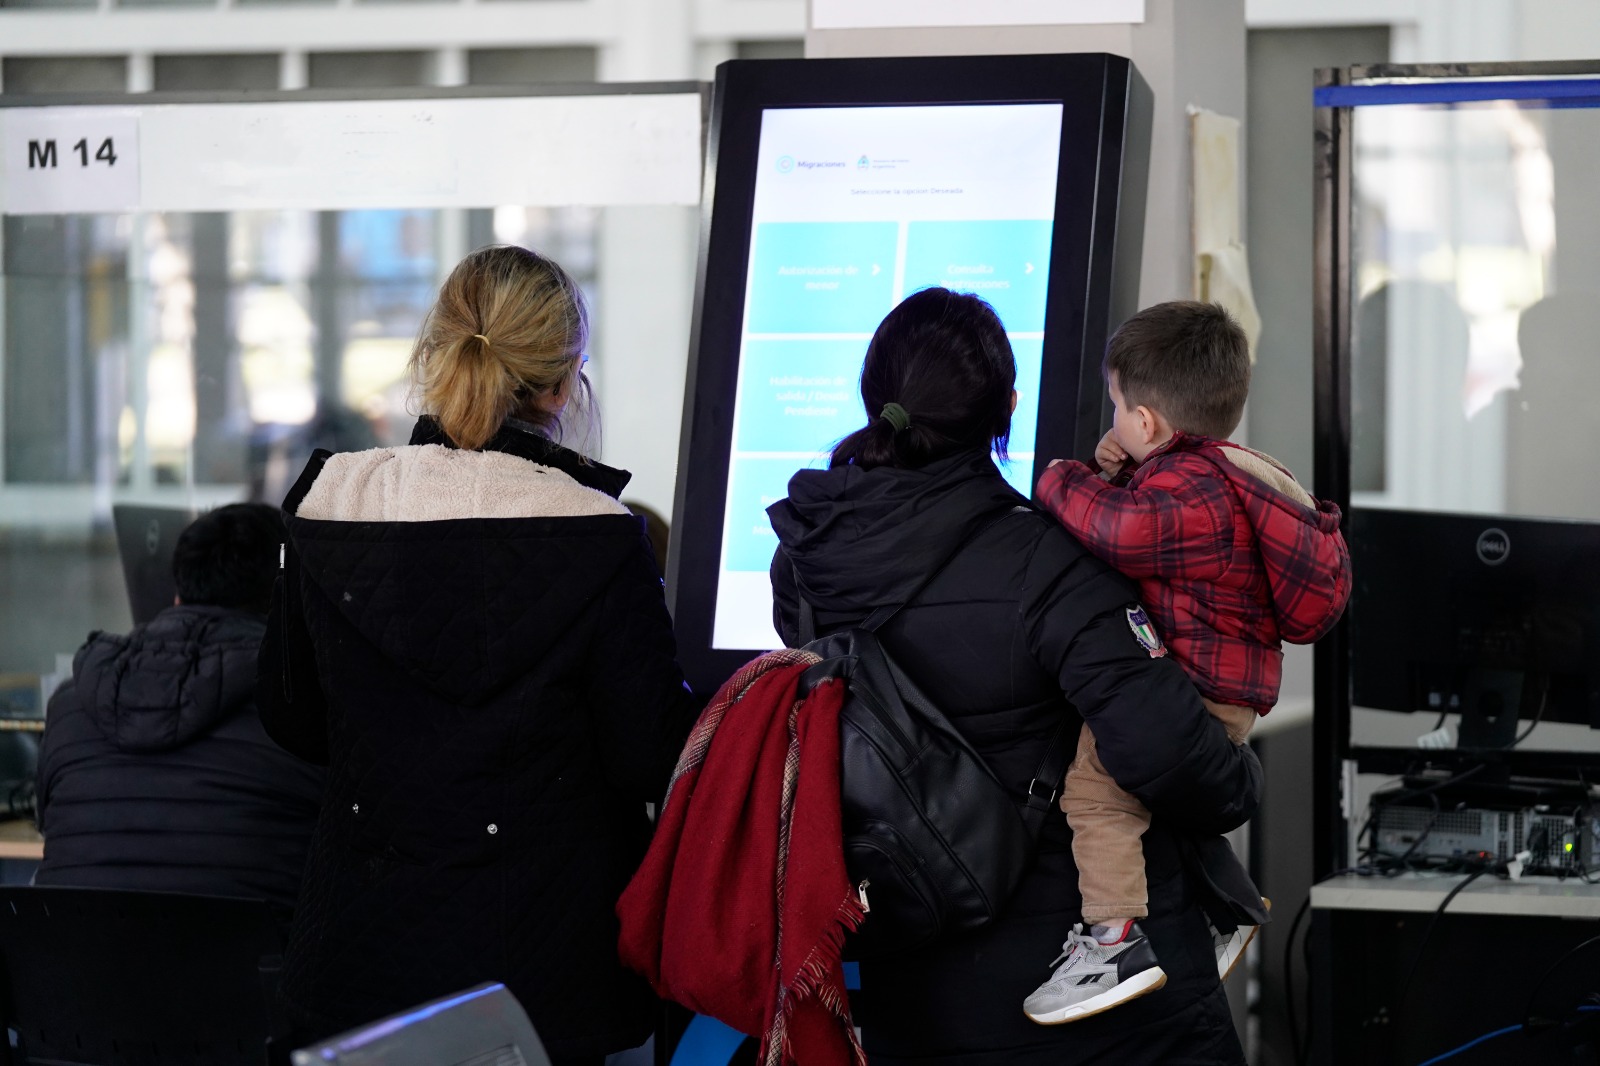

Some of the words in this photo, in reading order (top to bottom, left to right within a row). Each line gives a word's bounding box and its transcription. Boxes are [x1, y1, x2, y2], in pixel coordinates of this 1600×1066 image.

[28, 139, 58, 169] M
[73, 136, 118, 168] 14
[798, 160, 846, 169] Migraciones
[844, 264, 859, 275] de
[946, 263, 994, 275] Consulta
[805, 280, 840, 290] menor
[784, 406, 838, 417] Pendiente
[1481, 540, 1504, 553] DELL
